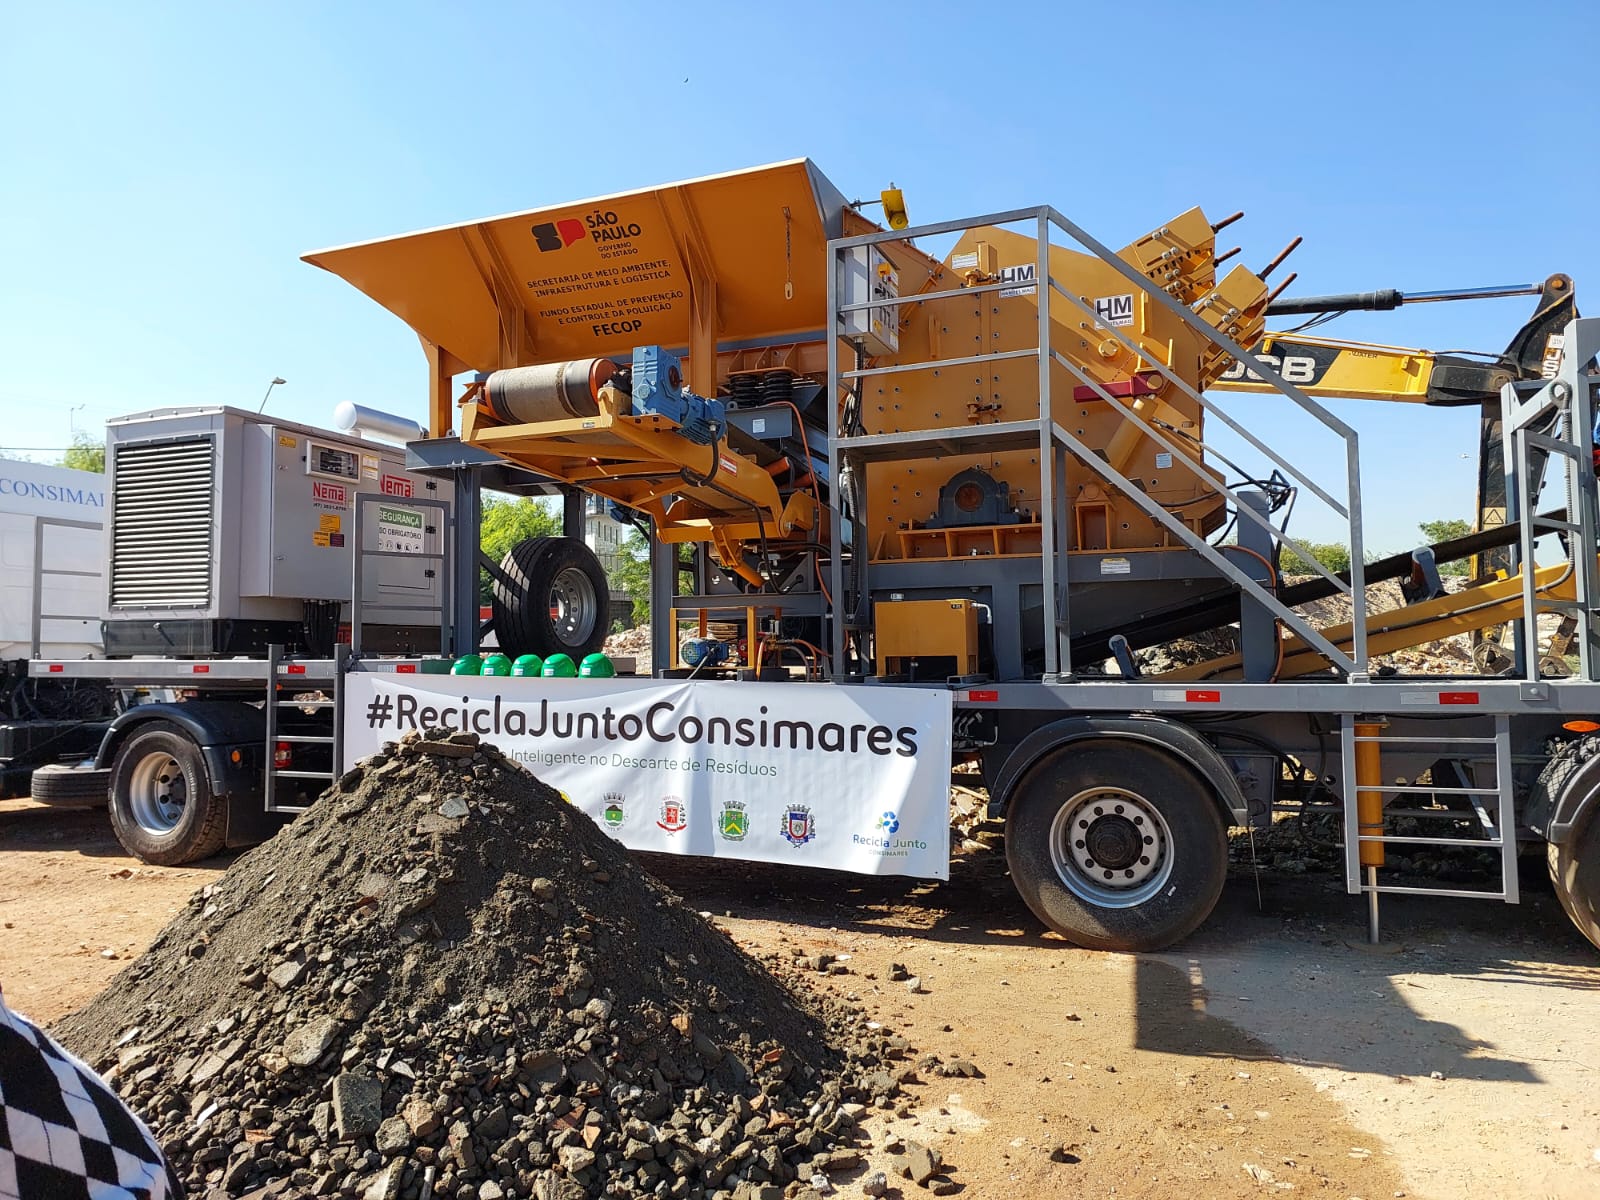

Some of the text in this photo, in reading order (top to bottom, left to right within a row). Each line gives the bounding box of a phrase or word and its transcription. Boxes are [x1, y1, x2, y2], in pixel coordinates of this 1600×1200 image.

[585, 210, 618, 229] SÃO
[591, 223, 642, 243] PAULO
[597, 242, 632, 252] GOVERNO
[612, 248, 638, 257] ESTADO
[527, 260, 671, 288] SECRETARIA DE MEIO AMBIENTE,
[534, 270, 671, 298] INFRAESTRUTURA E LOGÍSTICA
[540, 289, 684, 318] FUNDO ESTADUAL DE PREVENÇÃO
[565, 312, 610, 324] CONTROLE
[612, 309, 624, 318] DA
[626, 302, 672, 316] POLUIÇÃO
[592, 319, 642, 337] FECOP
[313, 481, 345, 501] Nema
[379, 510, 420, 527] SEGURANÇA
[388, 528, 422, 540] OBRIGATÓRIO
[367, 694, 918, 757] #ReciclaJuntoConsimares
[511, 748, 777, 777] Inteligente no Descarte de Resíduos
[853, 834, 927, 850] Recicla Junto
